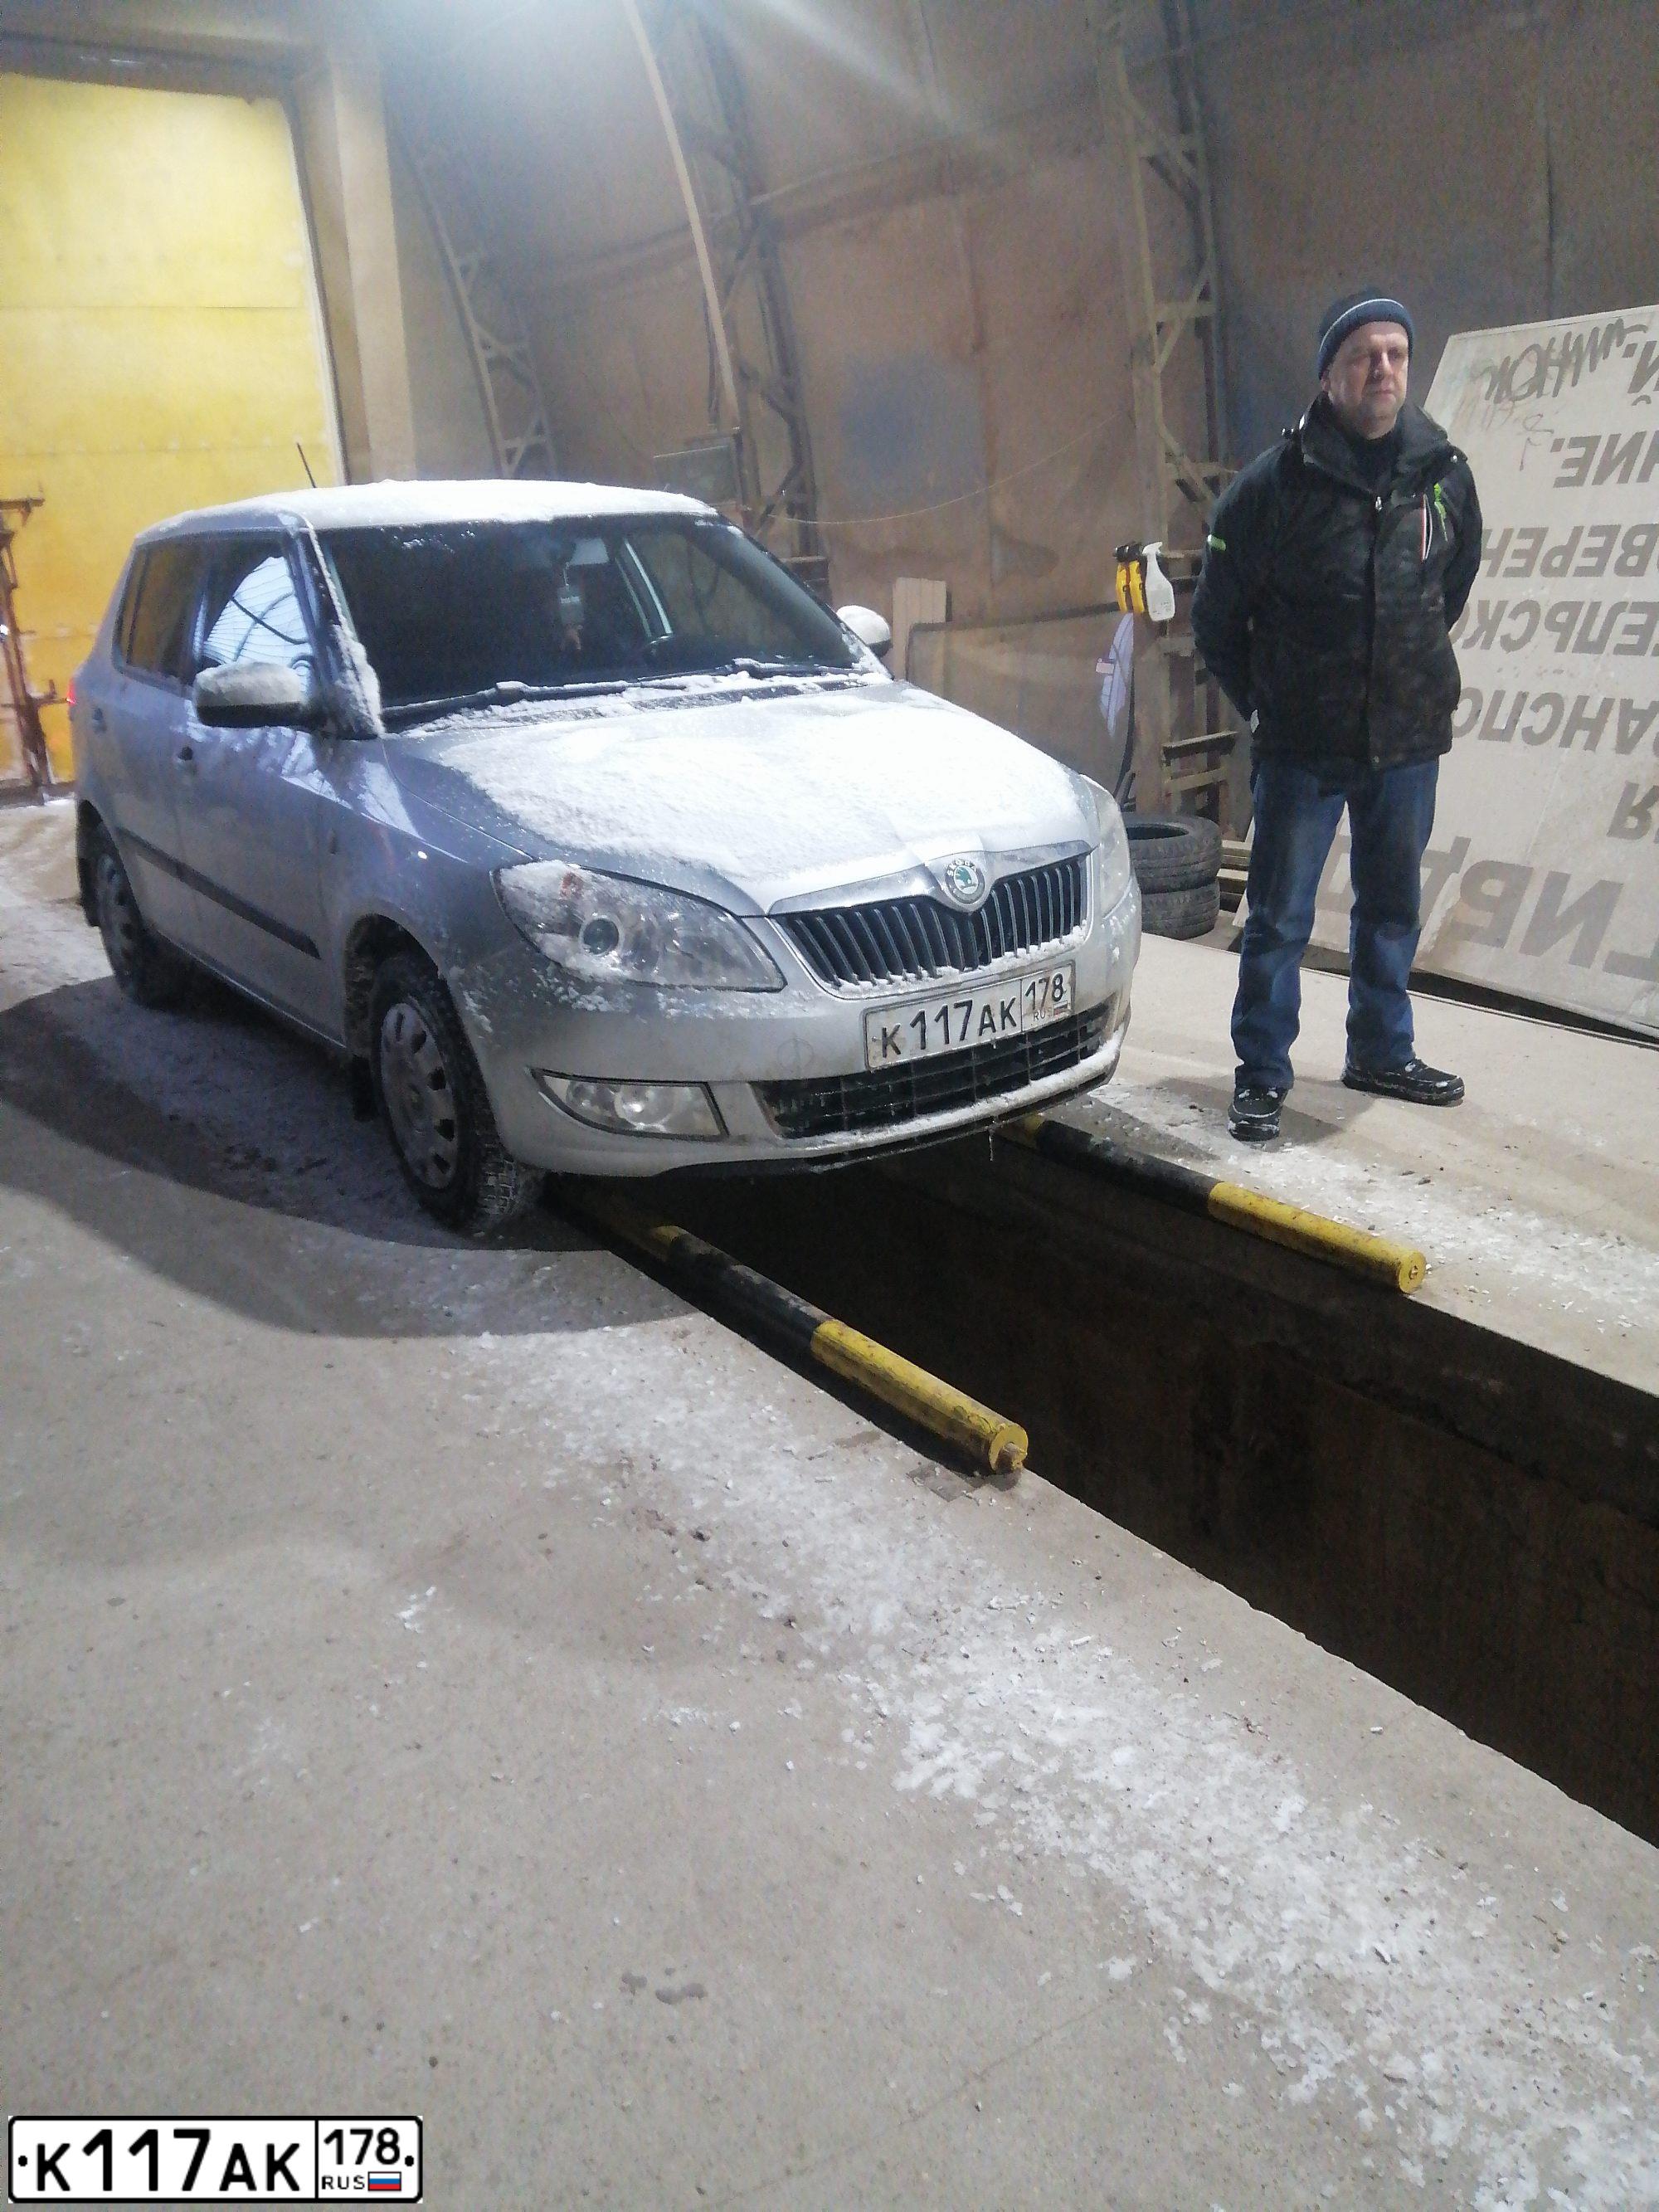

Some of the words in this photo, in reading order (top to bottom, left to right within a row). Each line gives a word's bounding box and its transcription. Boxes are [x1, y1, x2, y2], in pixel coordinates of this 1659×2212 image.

[1481, 523, 1659, 577] ВЕРЕН
[1450, 599, 1659, 656] ЕЛЬСК
[1451, 687, 1659, 758] АНСПО
[882, 996, 1017, 1058] К117АК
[1024, 972, 1064, 1011] 178
